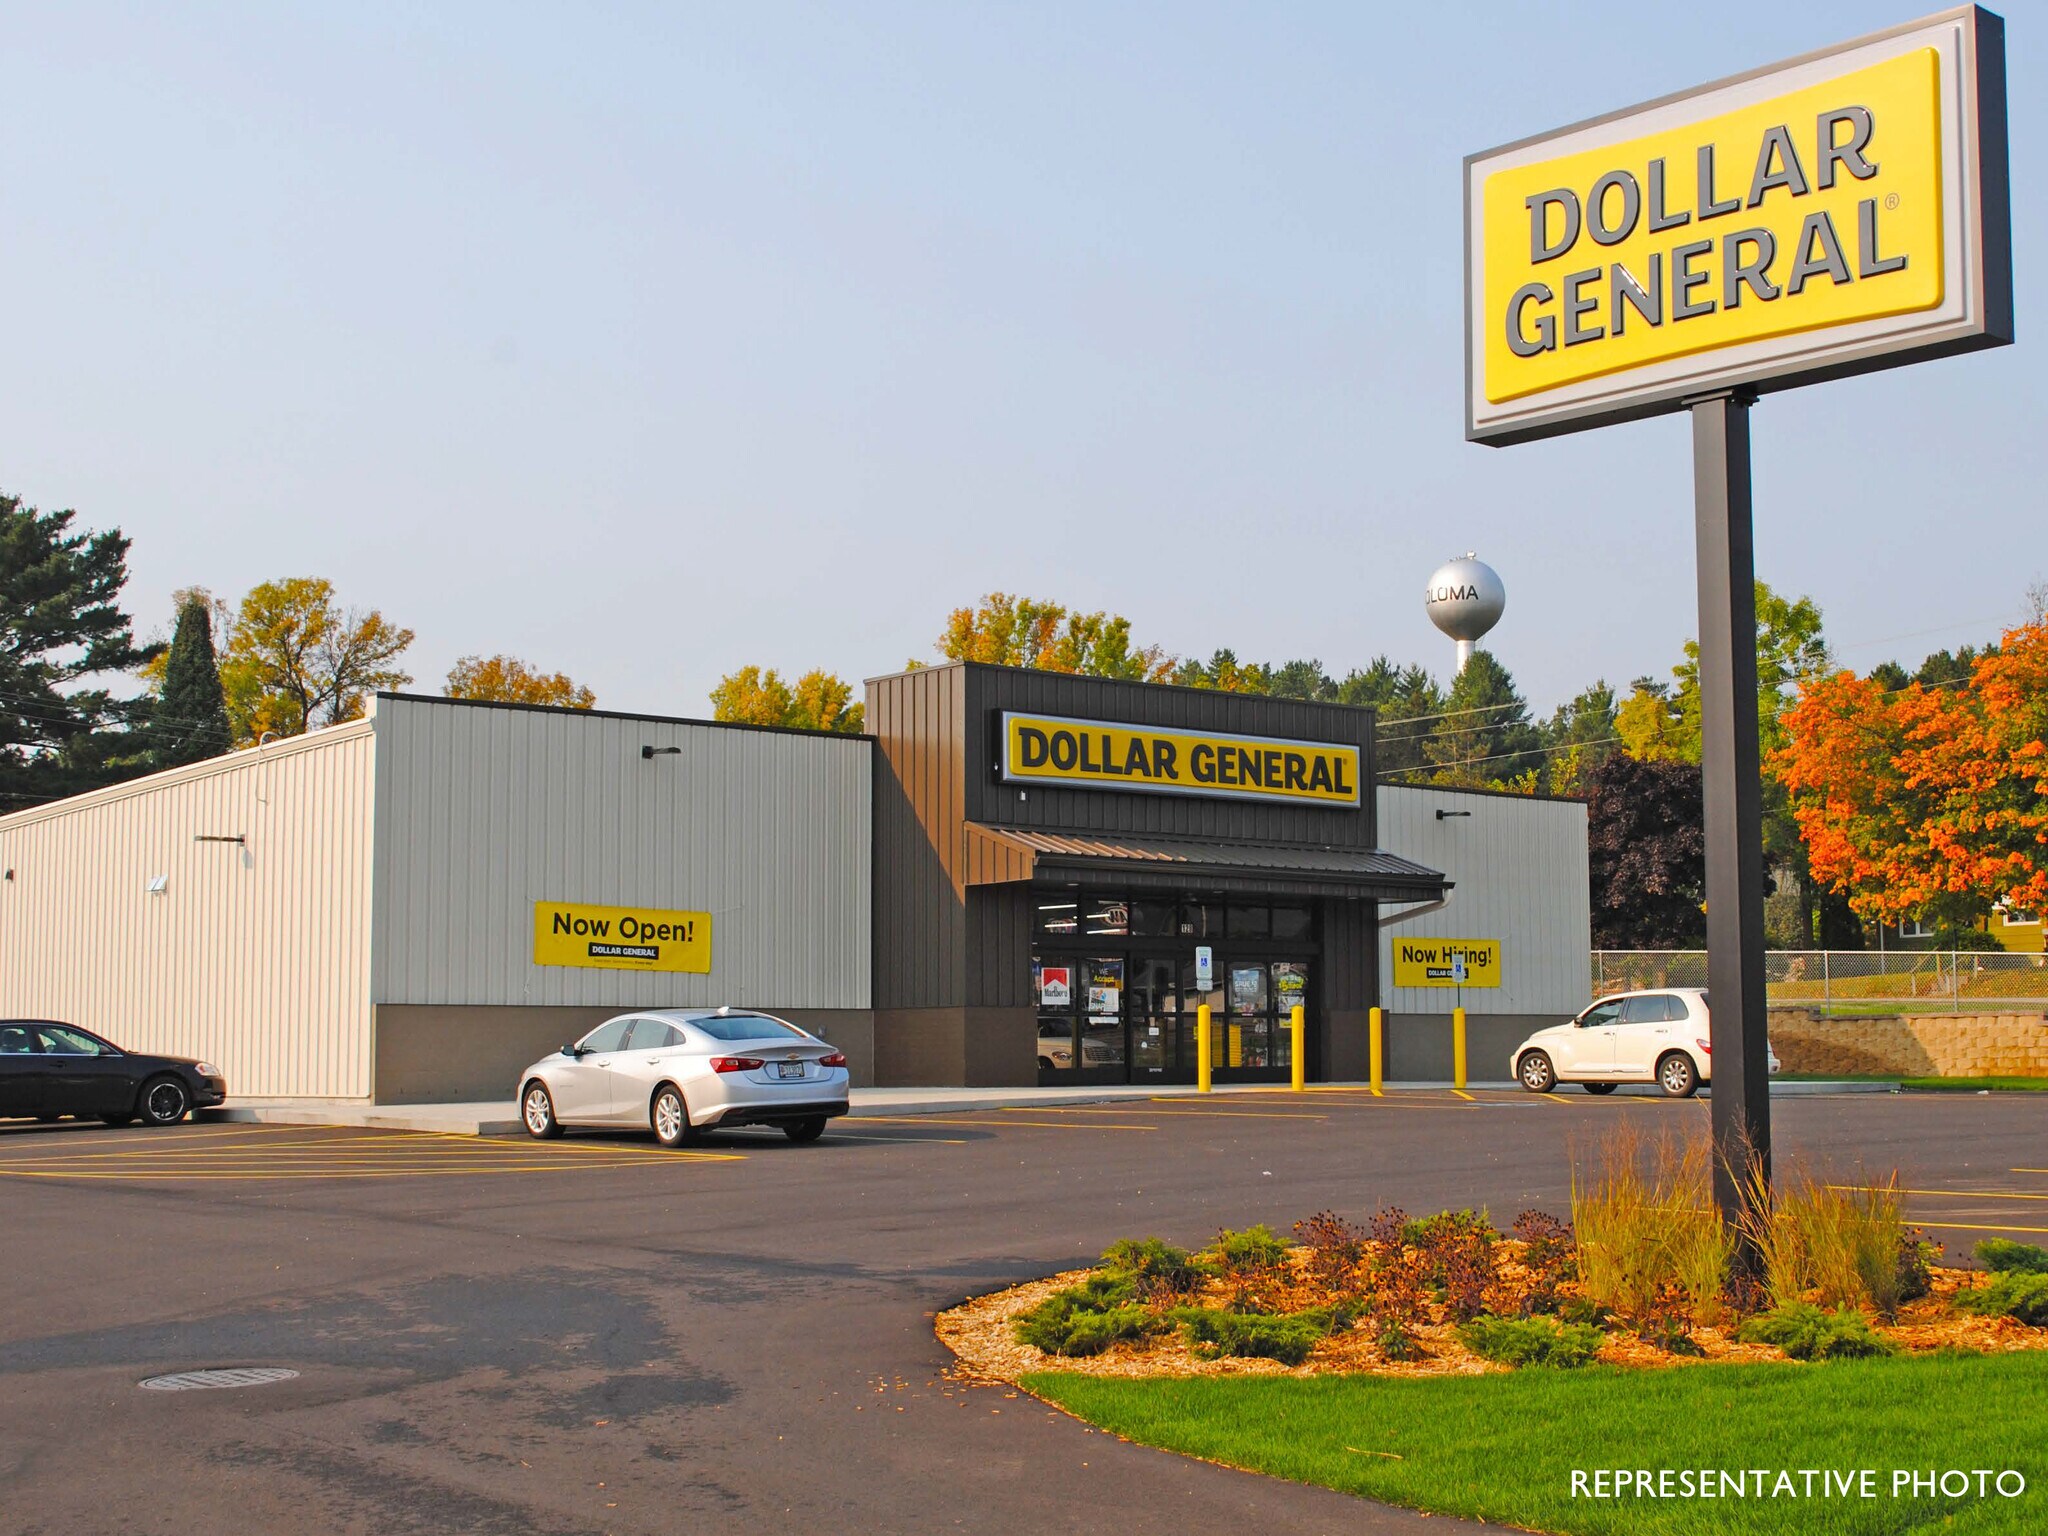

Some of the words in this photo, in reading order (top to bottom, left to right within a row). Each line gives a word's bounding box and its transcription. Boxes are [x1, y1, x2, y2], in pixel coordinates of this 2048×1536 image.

[1525, 105, 1879, 264] DOLLAR
[1505, 197, 1909, 357] GENERAL
[1425, 585, 1479, 604] OLOMA
[1018, 727, 1179, 780] DOLLAR
[1190, 744, 1353, 794] GENERAL
[553, 912, 611, 937] Now
[619, 916, 694, 943] Open!
[592, 945, 622, 955] DOLLAR
[622, 947, 656, 957] GENERAL
[1402, 945, 1437, 963] Now
